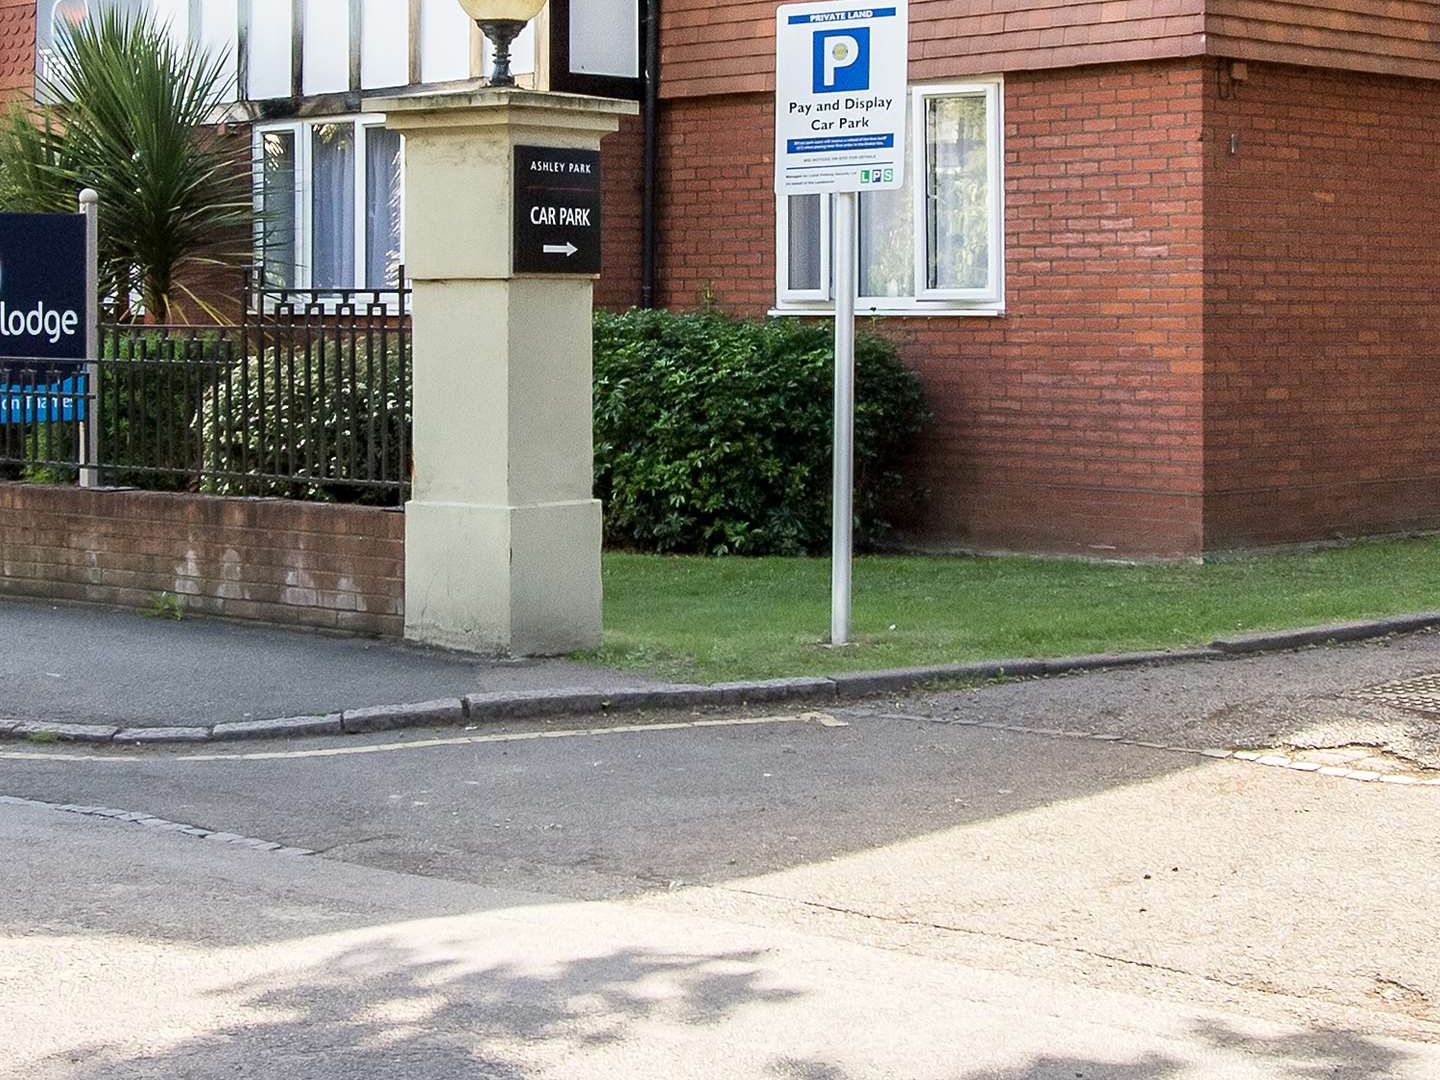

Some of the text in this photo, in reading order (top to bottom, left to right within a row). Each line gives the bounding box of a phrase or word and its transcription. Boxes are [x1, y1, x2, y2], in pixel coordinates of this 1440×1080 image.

[809, 10, 874, 23] PRIVATE LAND
[824, 35, 859, 86] P
[789, 97, 893, 116] Pay and Display
[811, 116, 869, 131] Car Park
[530, 161, 591, 174] ASHLEY PARK
[530, 206, 591, 226] CAR PARK
[23, 392, 73, 410] Tae
